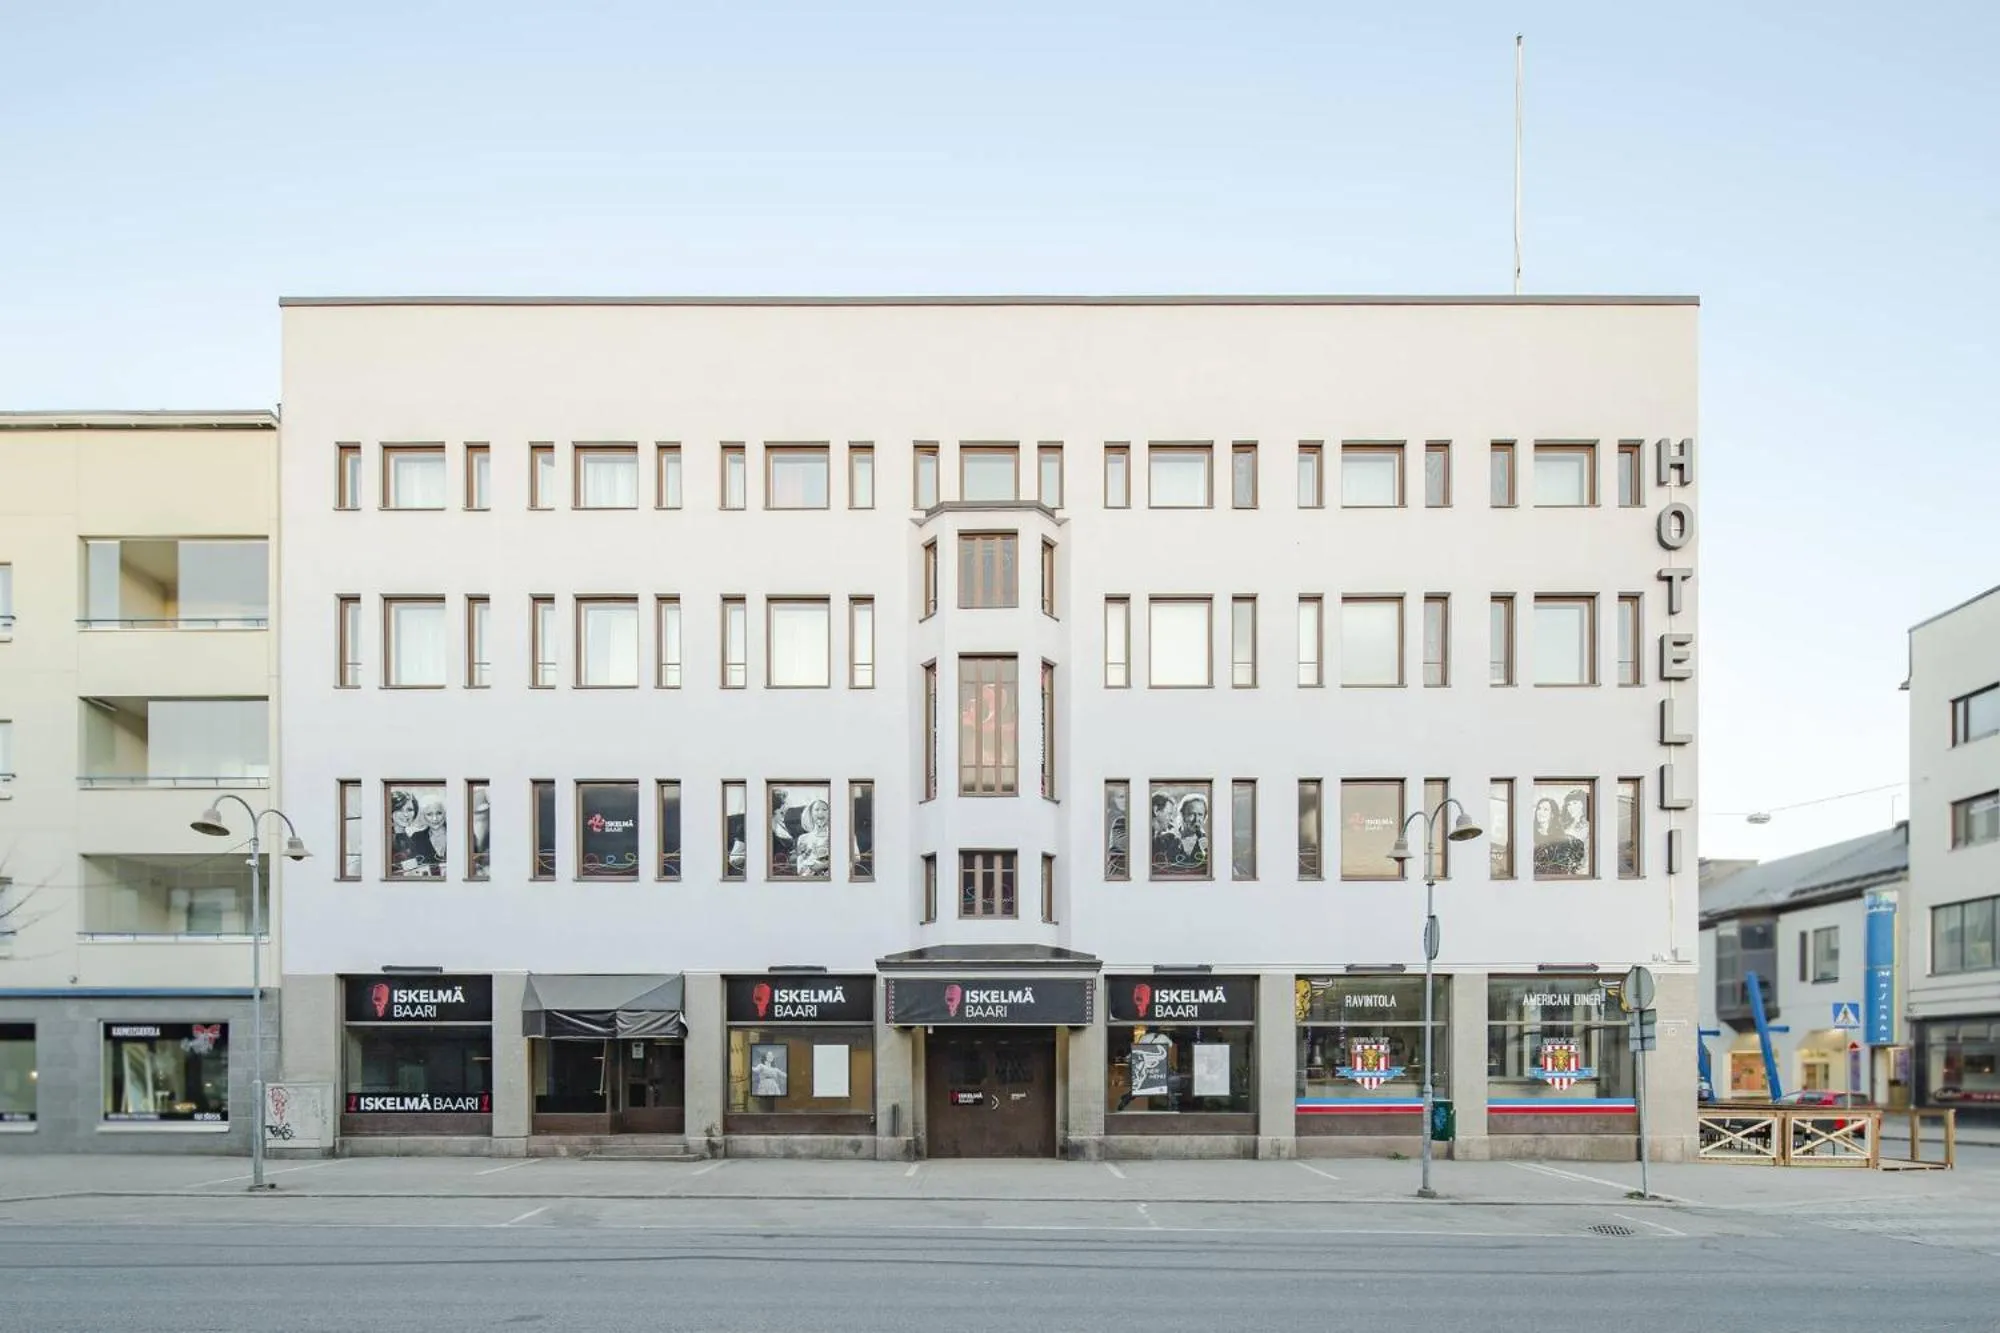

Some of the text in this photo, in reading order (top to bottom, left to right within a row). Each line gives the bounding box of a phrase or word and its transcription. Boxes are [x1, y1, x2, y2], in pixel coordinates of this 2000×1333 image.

[1656, 438, 1693, 875] HOTELLI
[392, 986, 465, 1003] ISKELMÄ
[774, 986, 846, 1003] ISKELMÄ
[965, 986, 1035, 1003] ISKELMÄ
[1154, 986, 1226, 1003] ISKELMÄ
[1345, 994, 1397, 1008] RAVINTOLA
[1522, 993, 1600, 1006] AMERICAN DINER
[393, 1004, 437, 1018] BAARI
[774, 1004, 817, 1018] BAARI
[965, 1004, 1008, 1018] BAARI
[1154, 1004, 1198, 1018] BAARI
[360, 1094, 479, 1110] ISKELMÄ BAARI
